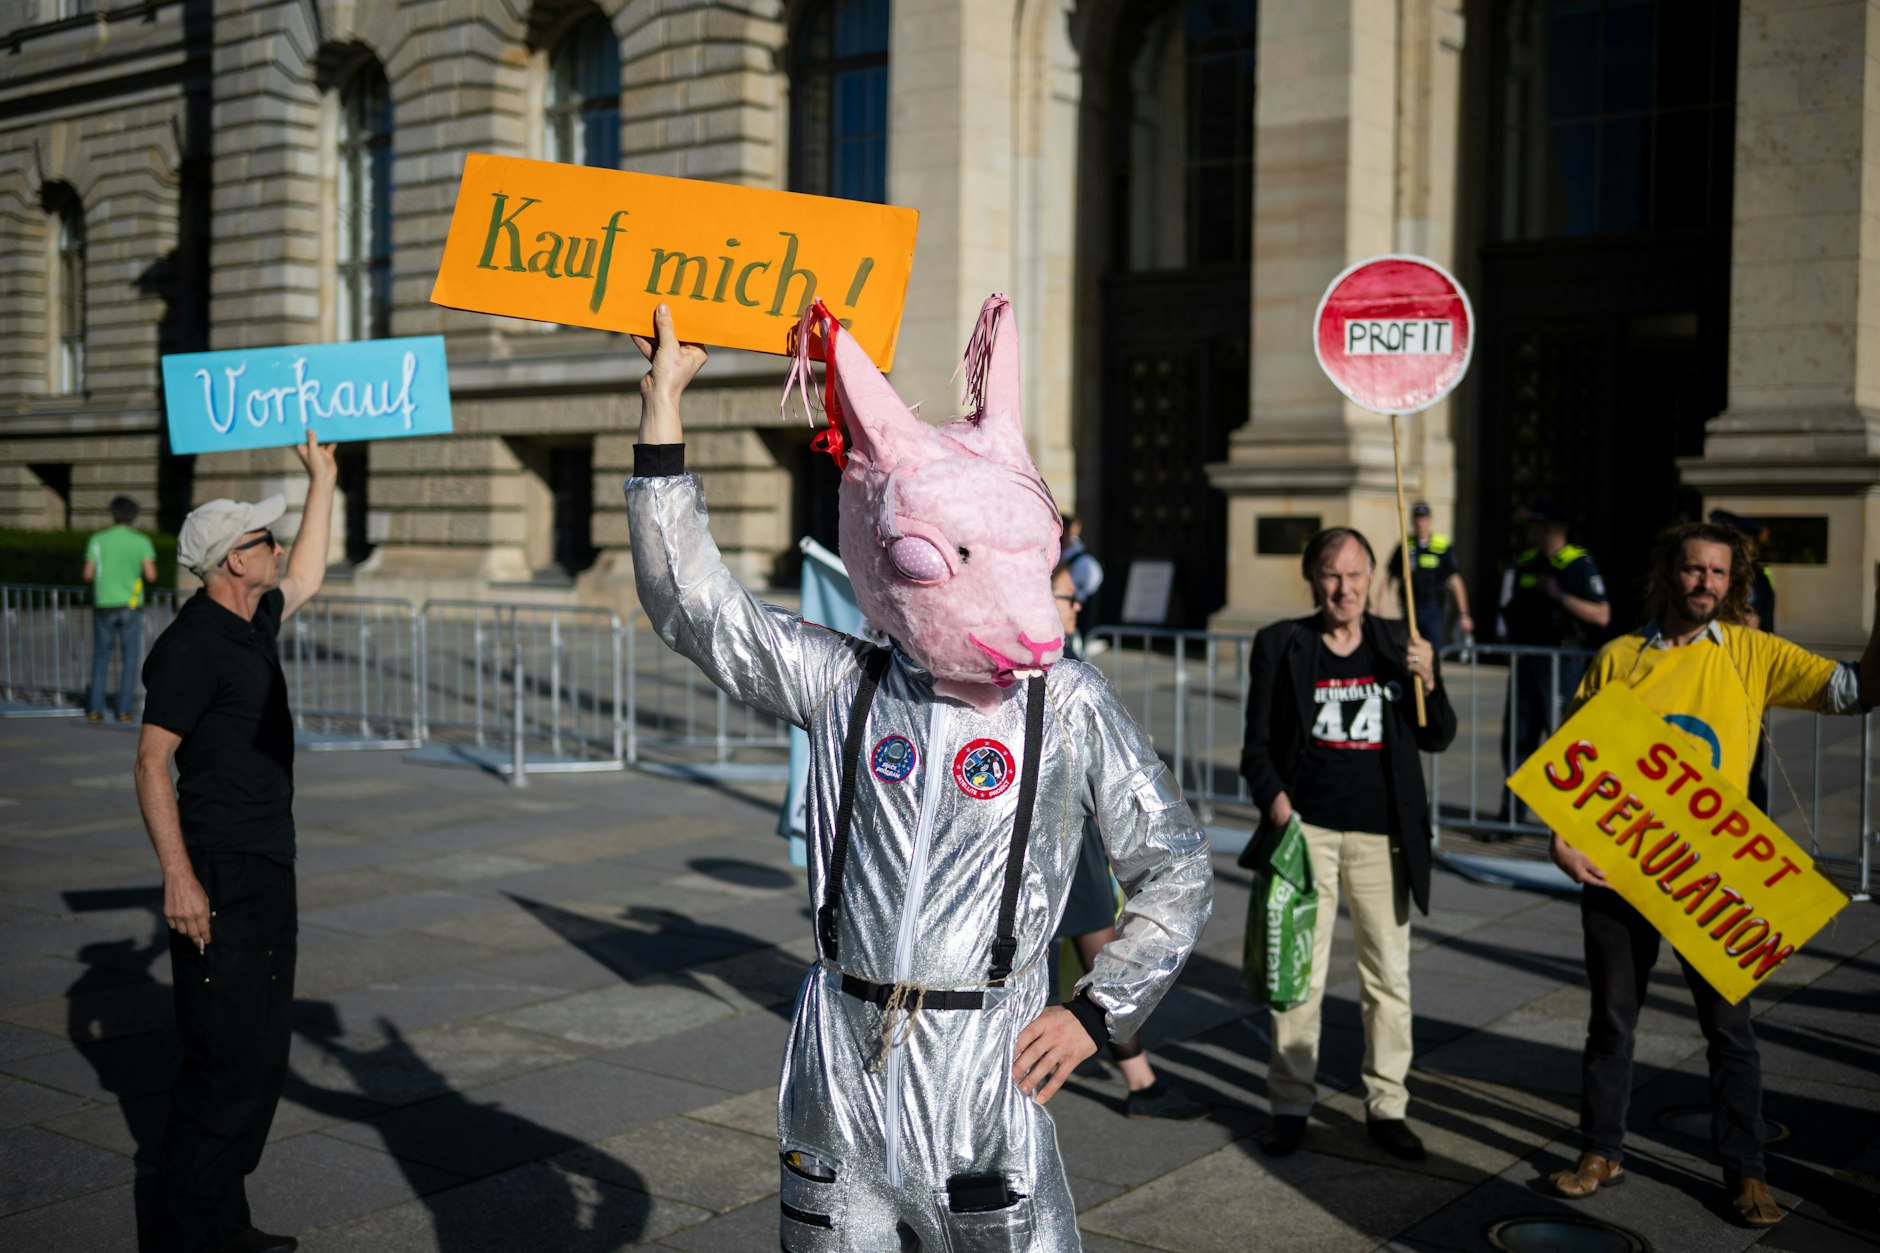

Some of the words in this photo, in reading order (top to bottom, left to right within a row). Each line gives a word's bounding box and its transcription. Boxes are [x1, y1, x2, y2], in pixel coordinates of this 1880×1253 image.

[476, 192, 629, 314] Kauf
[1349, 321, 1450, 354] PROFIT
[194, 350, 418, 434] Vorkauf
[1311, 697, 1383, 743] 44
[956, 774, 978, 796] SATELLITE
[988, 780, 1010, 797] PROJECT
[1636, 742, 1802, 888] STOPPT
[1544, 739, 1795, 981] SPEKULATION
